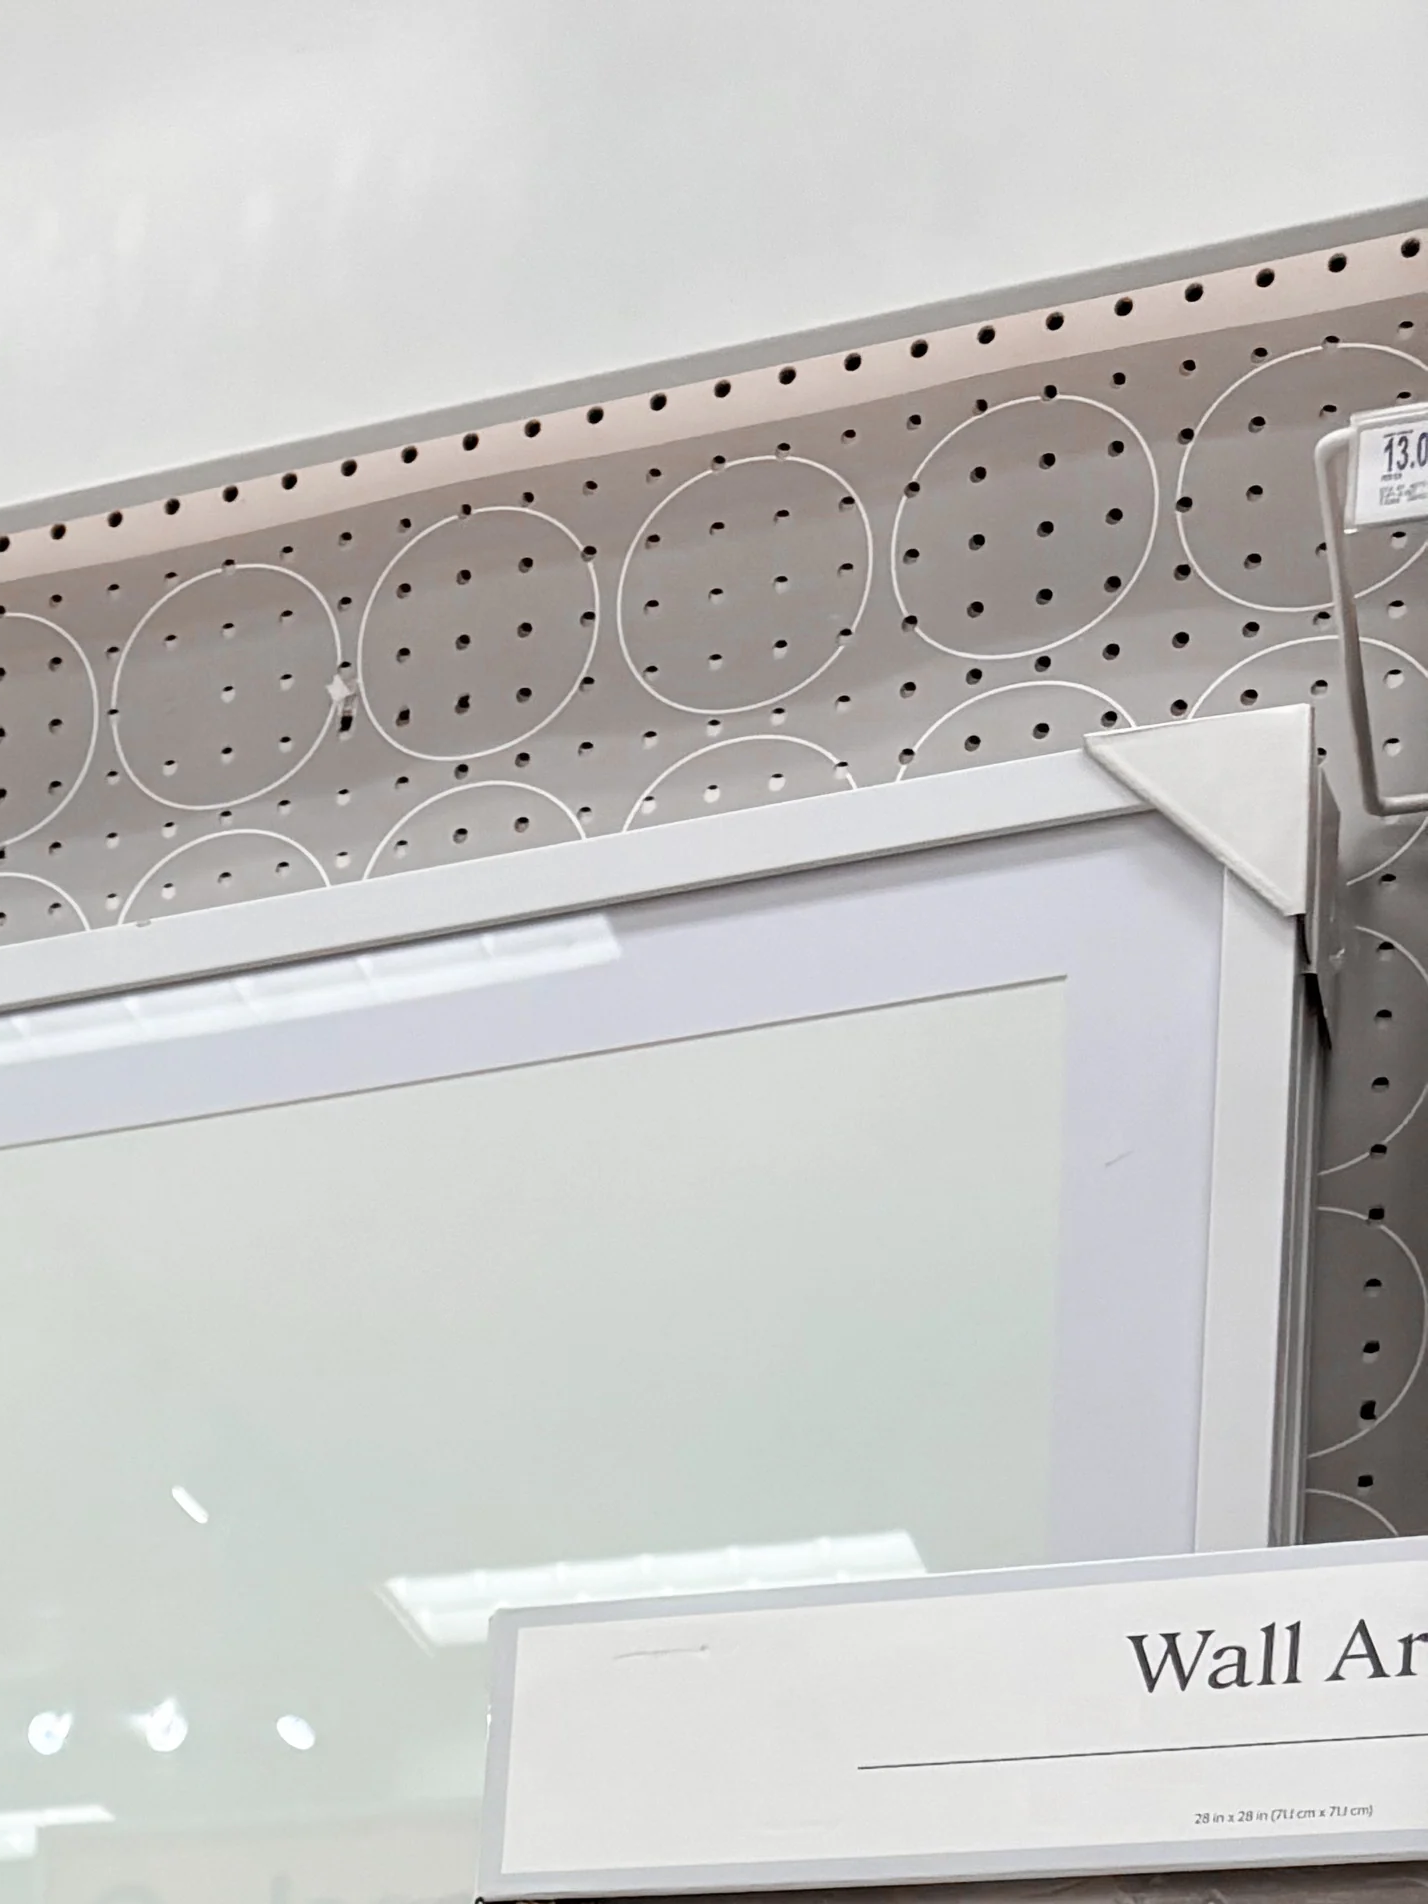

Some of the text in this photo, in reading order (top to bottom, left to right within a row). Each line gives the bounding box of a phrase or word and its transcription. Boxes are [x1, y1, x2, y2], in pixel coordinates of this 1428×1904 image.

[1126, 1620, 1303, 1693] Wall
[1194, 1812, 1211, 1825] 28
[1212, 1812, 1225, 1824] in
[1227, 1814, 1236, 1823] x
[1238, 1810, 1254, 1823] 28
[1255, 1810, 1268, 1822] in
[1296, 1808, 1316, 1820] cm
[1318, 1808, 1326, 1818] x
[1350, 1803, 1374, 1819] cm)
